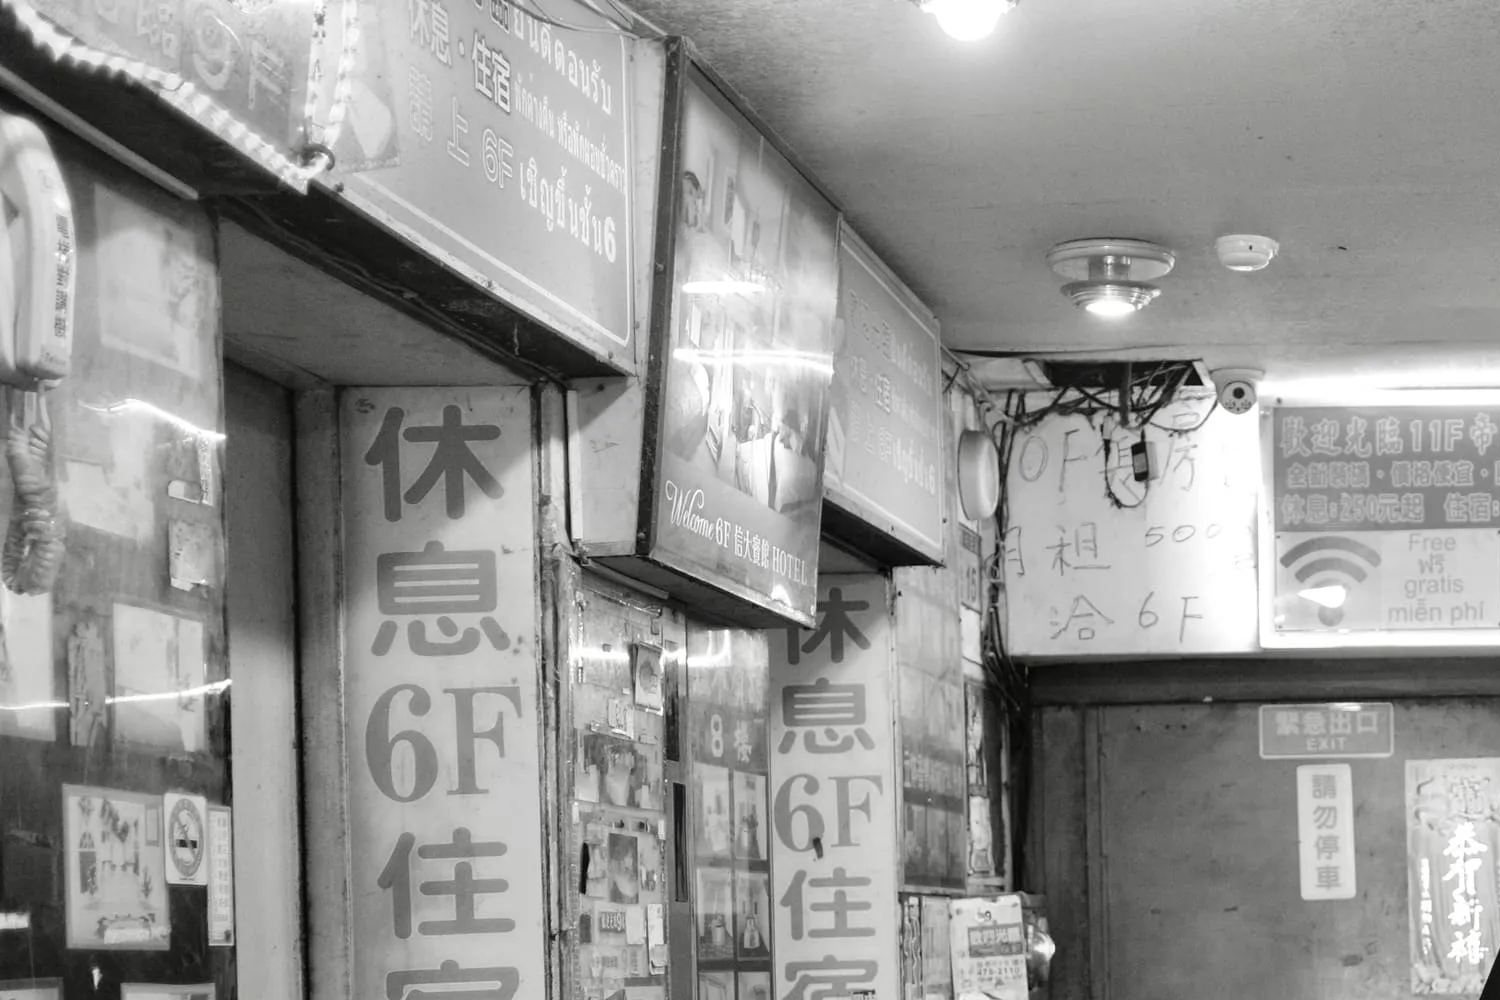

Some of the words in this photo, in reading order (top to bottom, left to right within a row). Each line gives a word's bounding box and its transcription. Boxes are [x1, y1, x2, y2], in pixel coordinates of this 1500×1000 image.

[472, 32, 512, 115] 住宿
[364, 403, 511, 657] 休息
[665, 480, 715, 541] Welcome
[715, 517, 731, 548] 6F
[772, 546, 807, 585] HOTEL
[1408, 532, 1457, 552] Free
[1403, 577, 1465, 600] gratis
[1450, 600, 1485, 626] phí
[364, 683, 523, 803] 6F
[1274, 710, 1379, 737] 緊急出口
[1306, 737, 1347, 751] EXIT
[773, 773, 884, 853] 6F
[1310, 773, 1341, 891] 請勿停車
